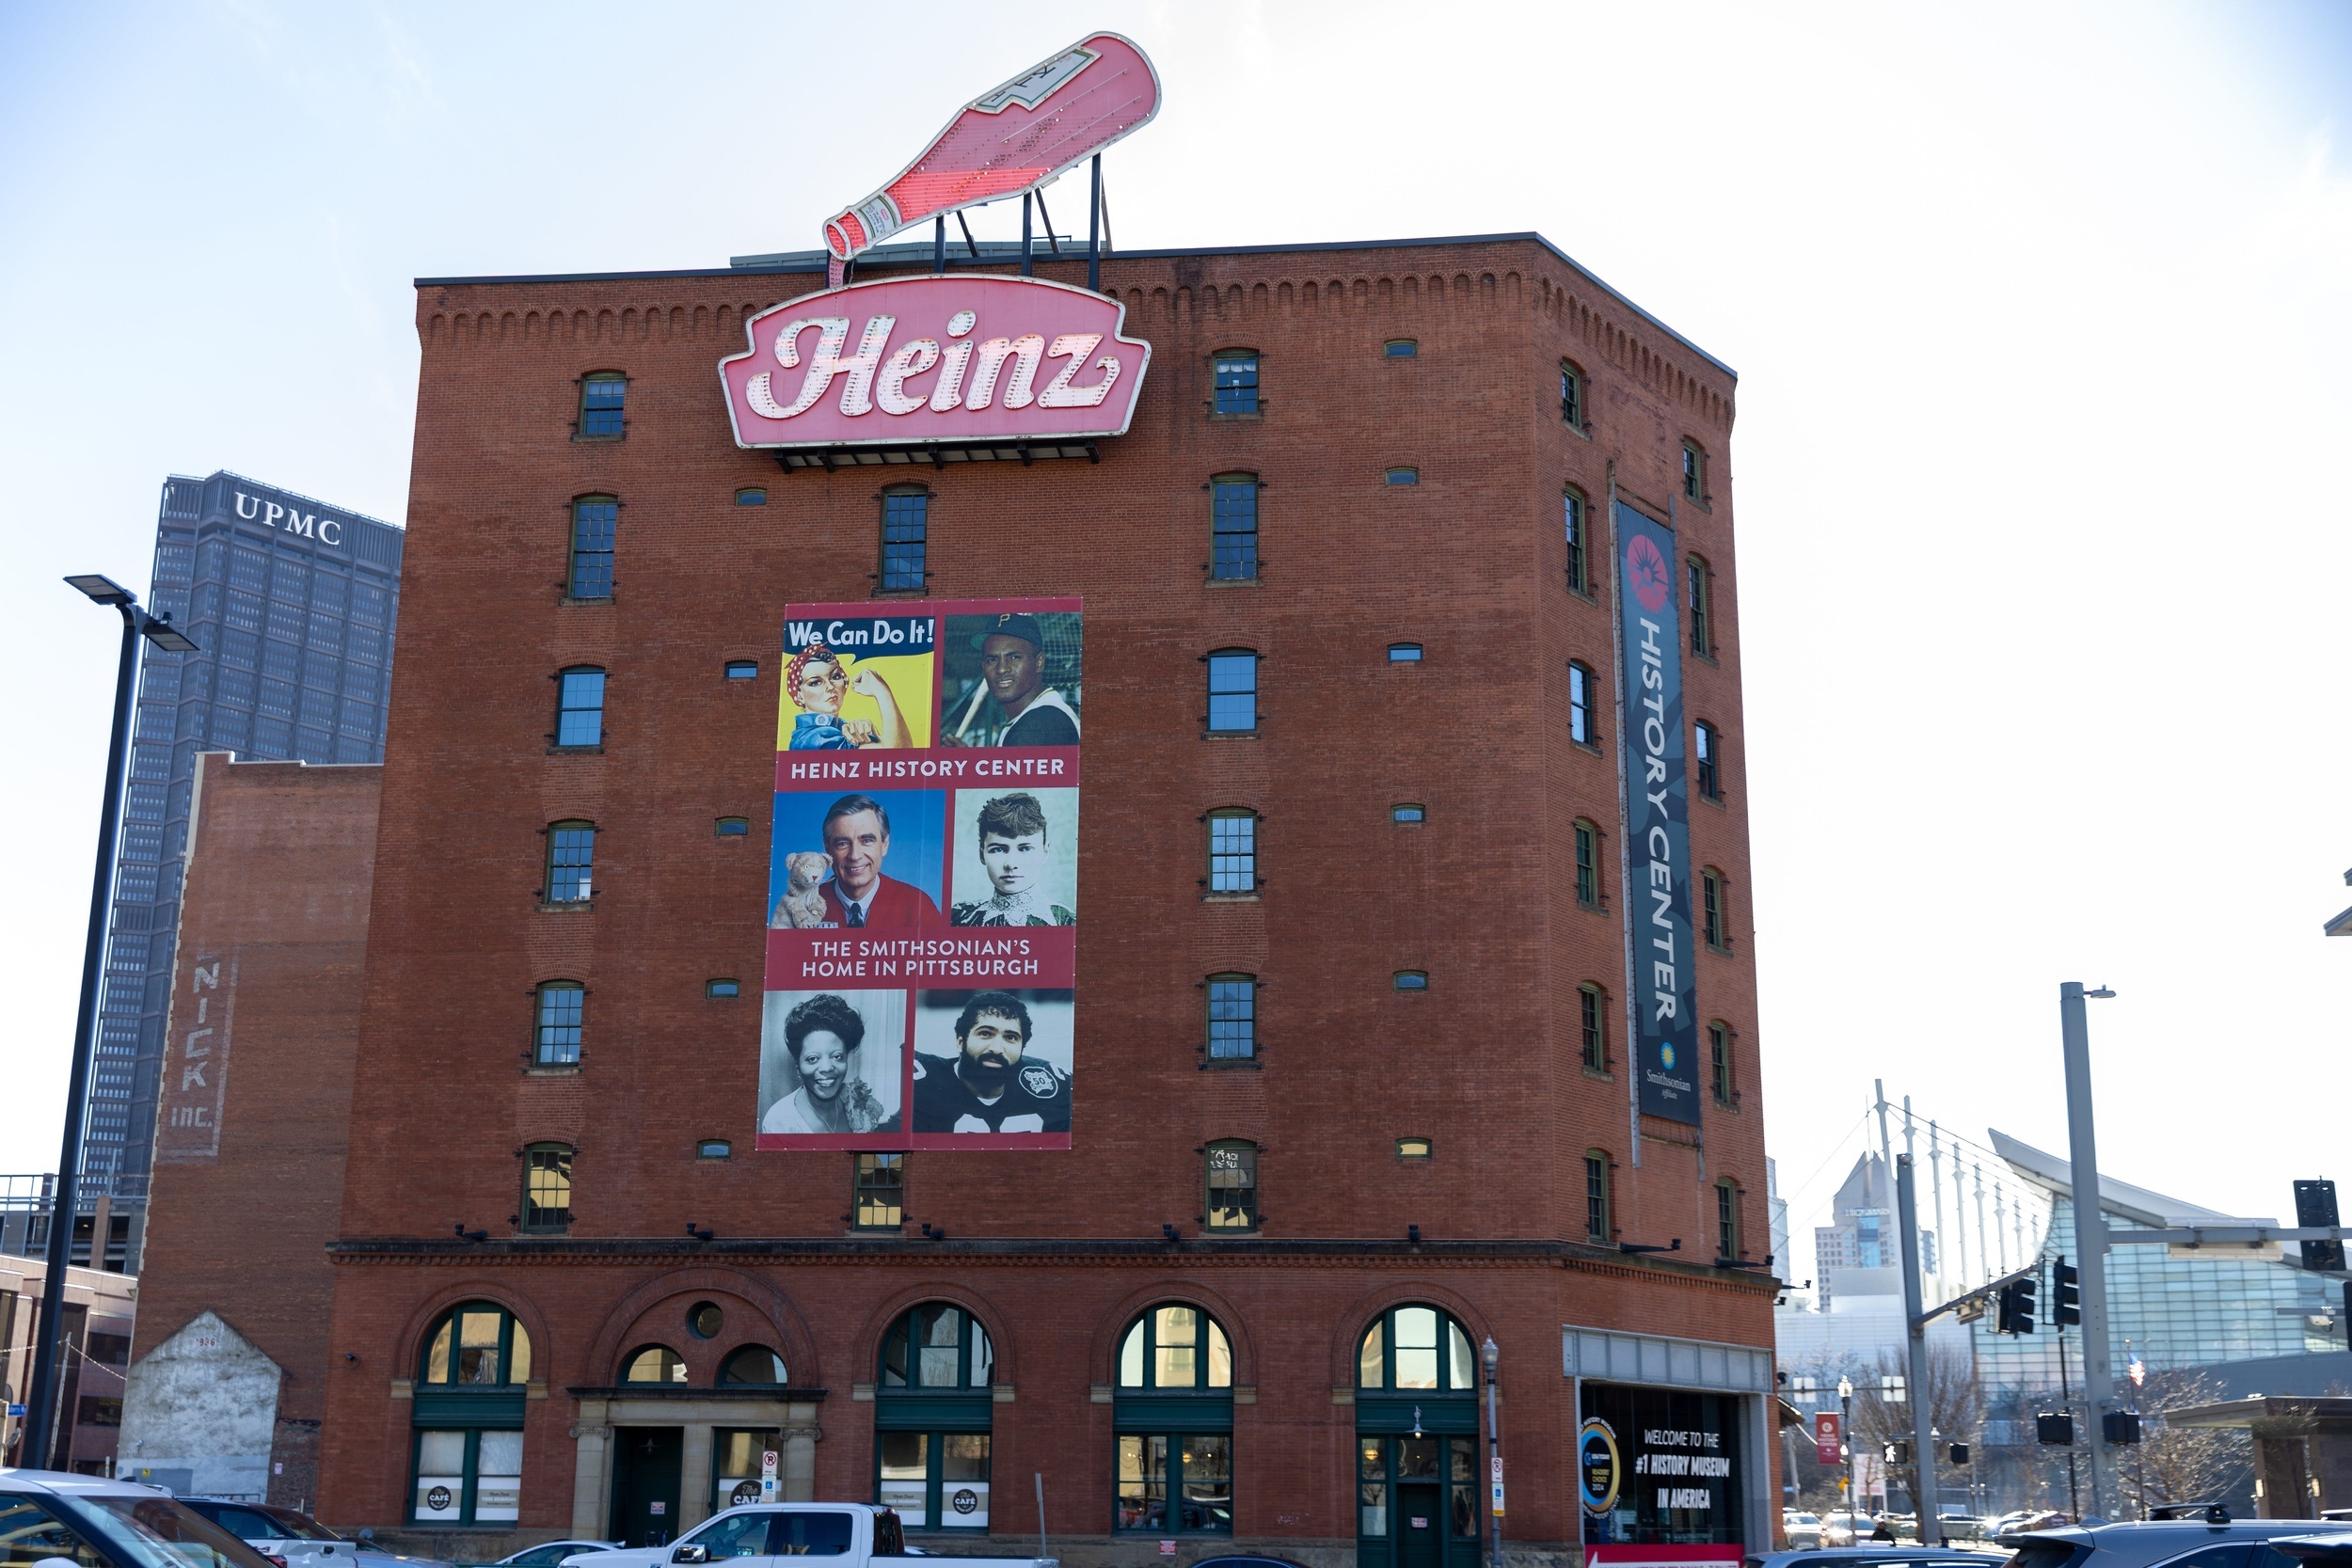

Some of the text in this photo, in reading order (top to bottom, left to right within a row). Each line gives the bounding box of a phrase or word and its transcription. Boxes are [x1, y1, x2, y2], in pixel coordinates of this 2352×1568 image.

[746, 310, 1121, 420] Heinz
[235, 492, 341, 546] UPMC
[788, 619, 935, 646] We Can Do It!
[791, 758, 1064, 779] HEINZ HISTORY CENTER
[1640, 617, 1677, 1022] HISTORY CENTER
[811, 939, 1030, 957] THE SMITHSONIAN'S
[803, 959, 1038, 976] HOME IN PITTSBURGH
[1646, 1069, 1691, 1092] Smithsonian
[1644, 1429, 1719, 1448] WELCOME TO THE
[1635, 1454, 1730, 1477] #1 HISTORY MUSEUM
[742, 1485, 759, 1494] The
[1657, 1488, 1711, 1509] IN AMERICA
